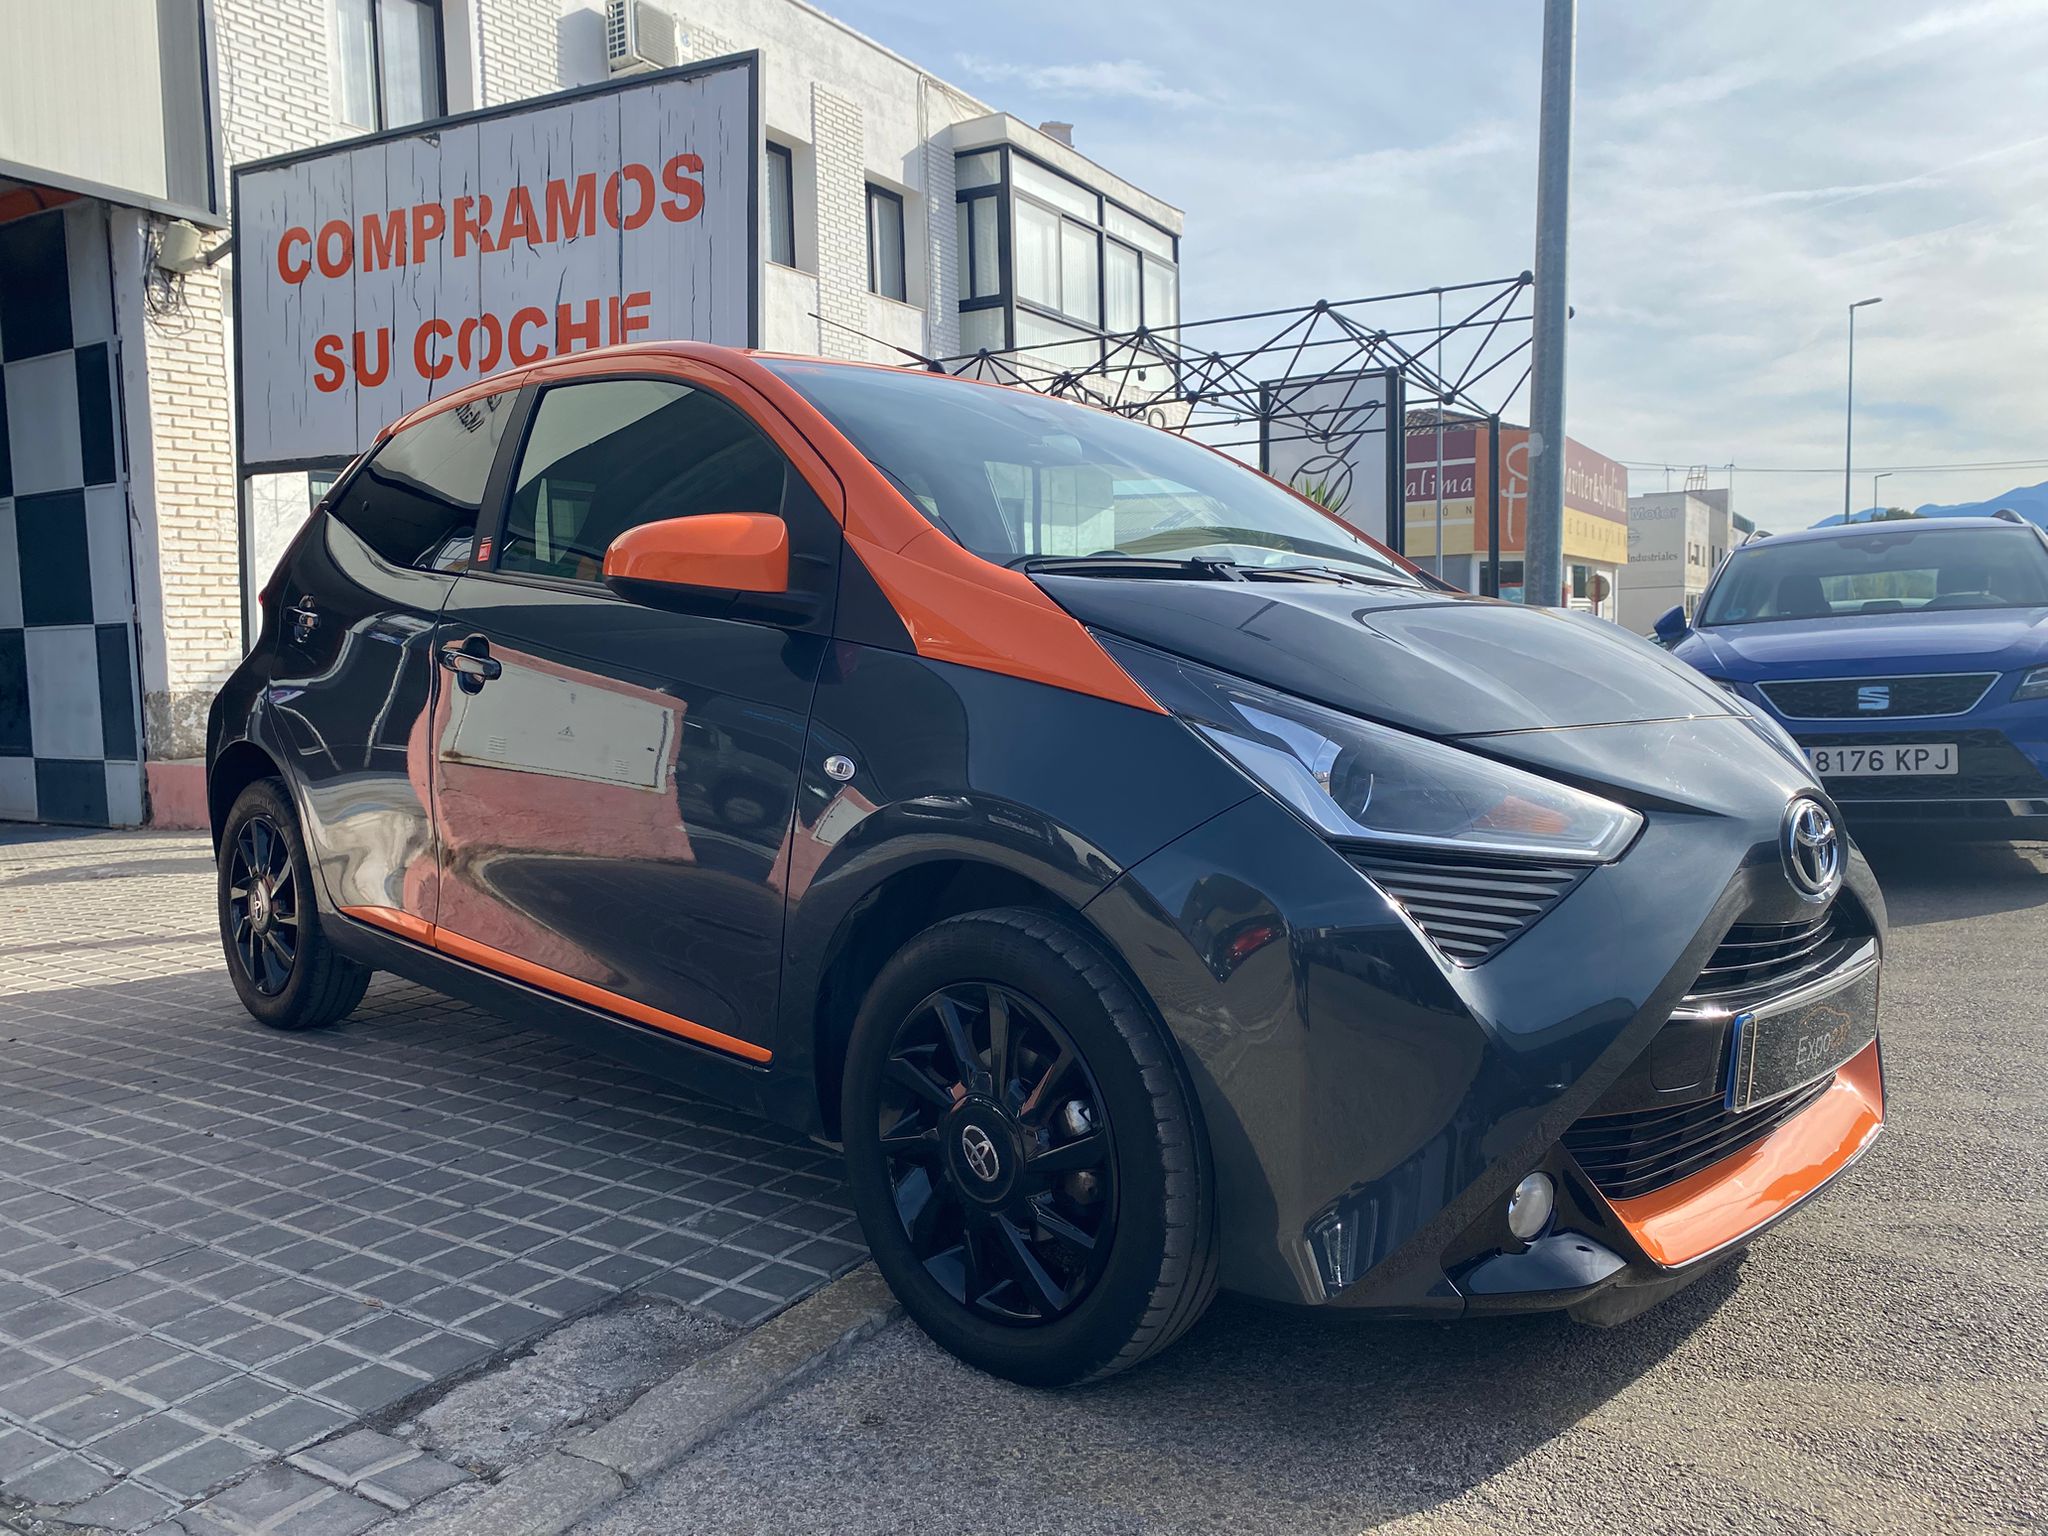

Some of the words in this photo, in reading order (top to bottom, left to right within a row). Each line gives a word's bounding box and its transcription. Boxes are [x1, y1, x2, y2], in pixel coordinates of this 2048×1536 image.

[277, 153, 706, 284] COMPRAMOS
[313, 327, 390, 392] SU
[413, 291, 652, 380] COCHE
[1630, 506, 1681, 520] Motor
[1815, 750, 1884, 773] 8176
[1895, 748, 1950, 771] KPJ
